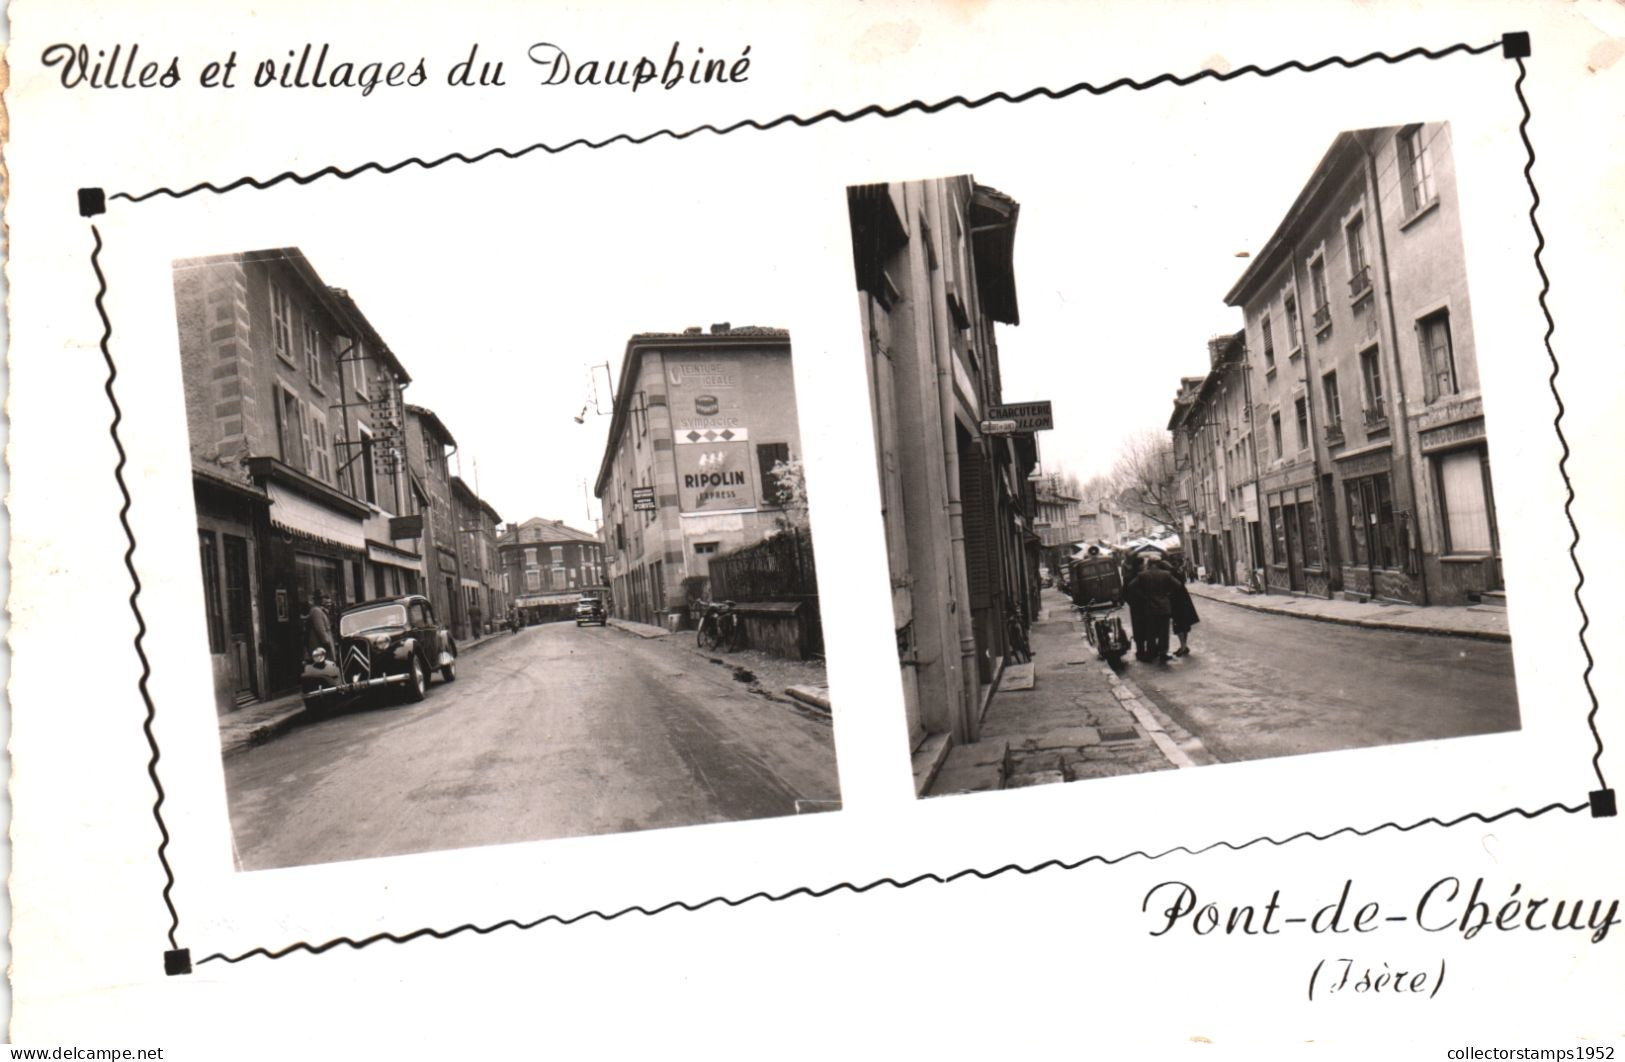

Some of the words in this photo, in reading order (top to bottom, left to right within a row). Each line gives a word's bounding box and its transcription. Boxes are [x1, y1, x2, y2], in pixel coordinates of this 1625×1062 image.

[988, 405, 1050, 419] CHARCUTERIE
[684, 470, 745, 488] RIPOLIN
[699, 490, 736, 501] EXPRESS
